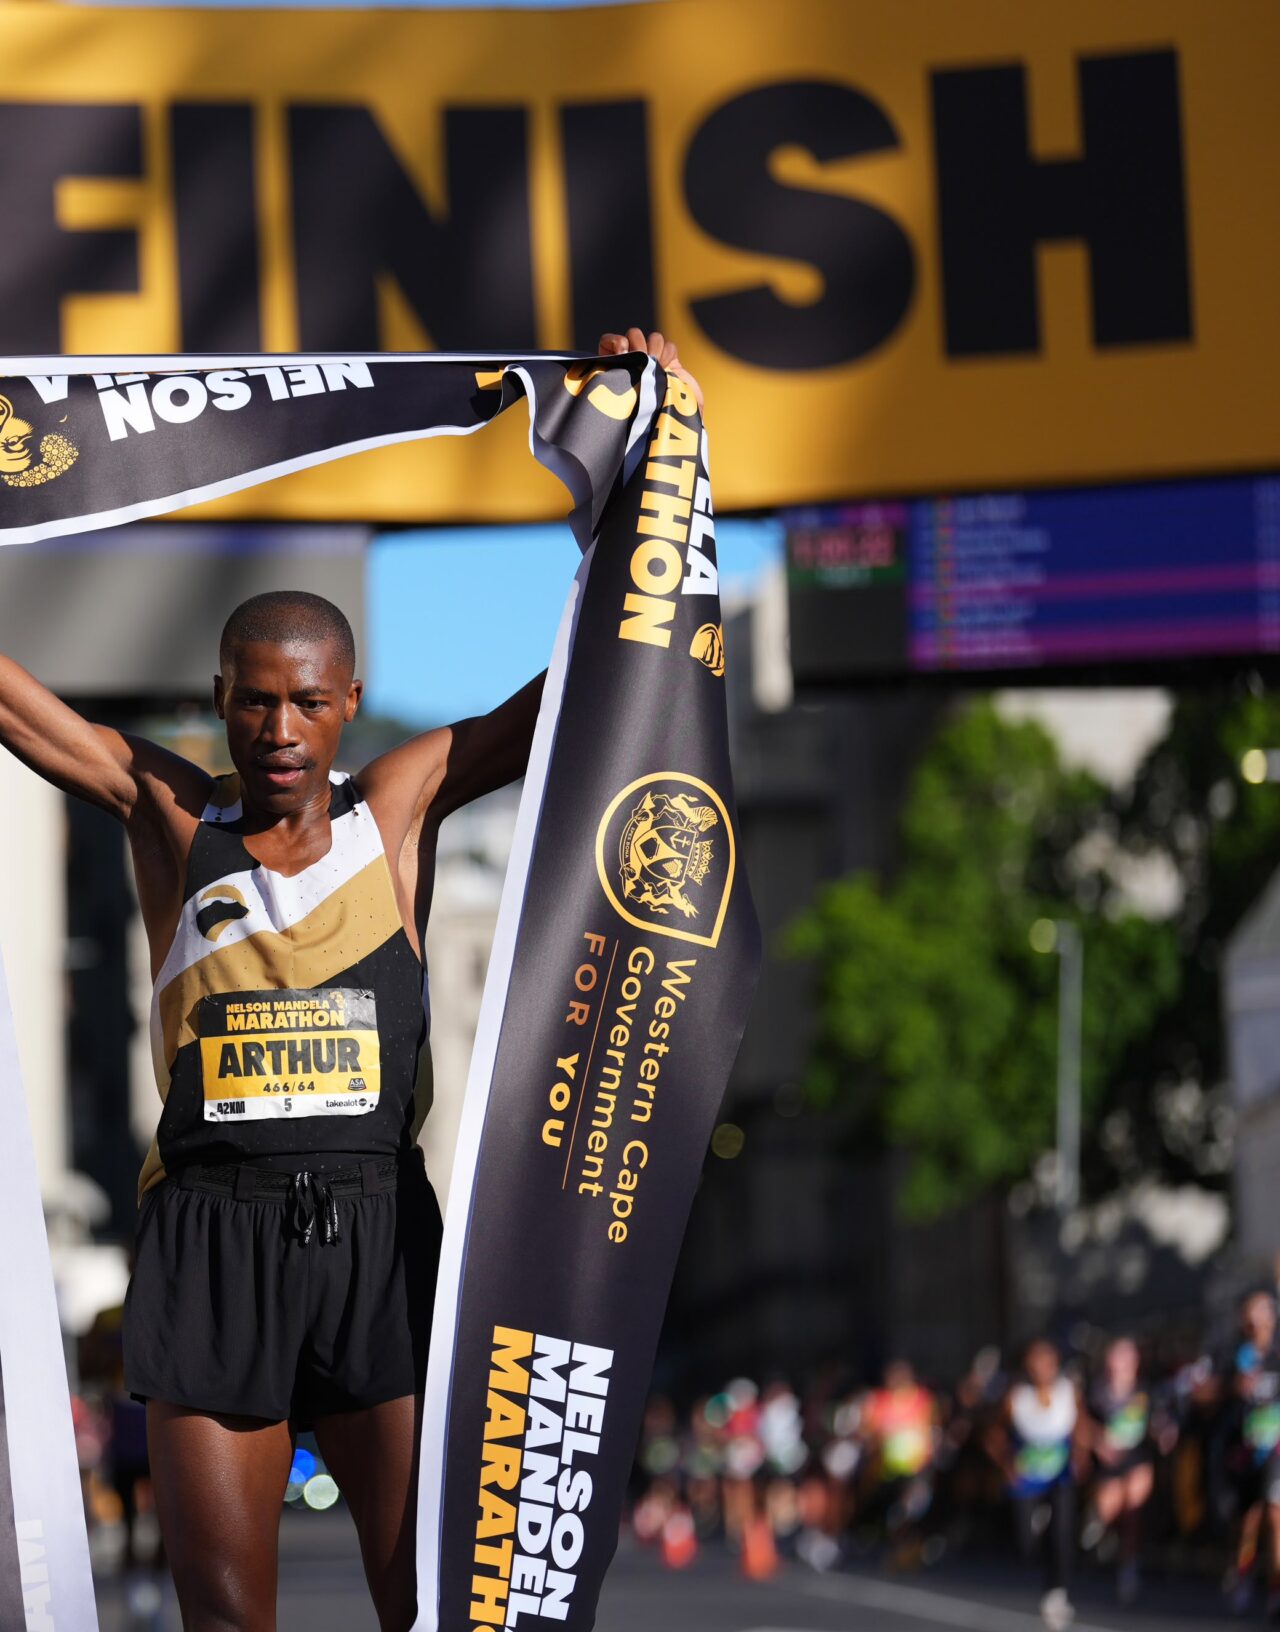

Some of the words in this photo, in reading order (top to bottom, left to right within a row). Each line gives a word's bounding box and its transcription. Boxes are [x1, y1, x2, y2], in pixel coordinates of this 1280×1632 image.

[98, 362, 375, 442] NELSON
[226, 1001, 271, 1014] NELSON
[273, 999, 330, 1012] MANDELA
[226, 1010, 345, 1032] MARATHON
[565, 931, 606, 1026] FOR
[218, 1037, 362, 1079] ARTHUR
[578, 945, 655, 1198] Government
[631, 958, 697, 1123] Western
[216, 1100, 246, 1115] 42KM
[284, 1097, 293, 1112] 5
[541, 1052, 580, 1148] YOU
[607, 1138, 649, 1244] Cape
[469, 1325, 534, 1632] MARATH
[504, 1333, 572, 1632] MANDEL
[539, 1342, 615, 1621] NELSON
